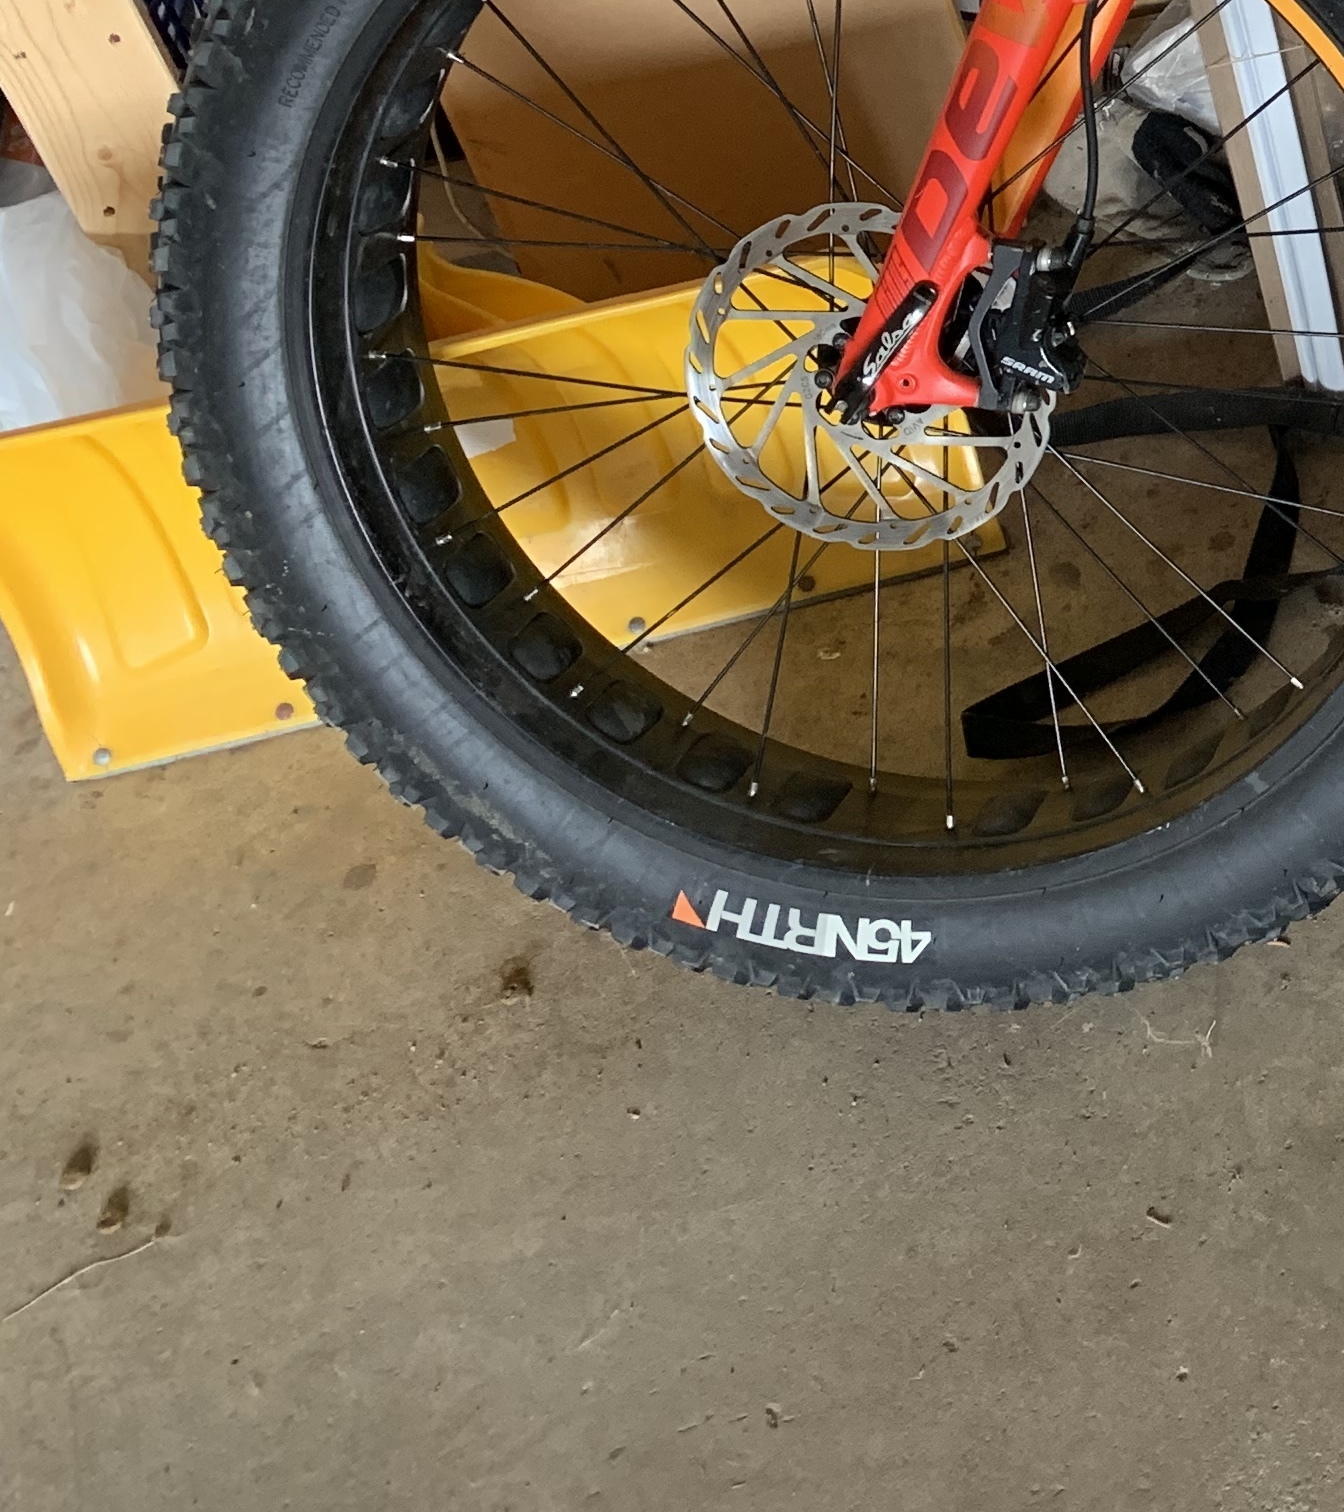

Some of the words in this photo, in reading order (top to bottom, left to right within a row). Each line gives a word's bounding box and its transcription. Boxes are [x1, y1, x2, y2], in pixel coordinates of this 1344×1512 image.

[861, 308, 924, 387] Salsa
[1001, 355, 1055, 384] SRAM
[903, 417, 924, 437] AVID
[705, 889, 932, 964] 45NRTH
